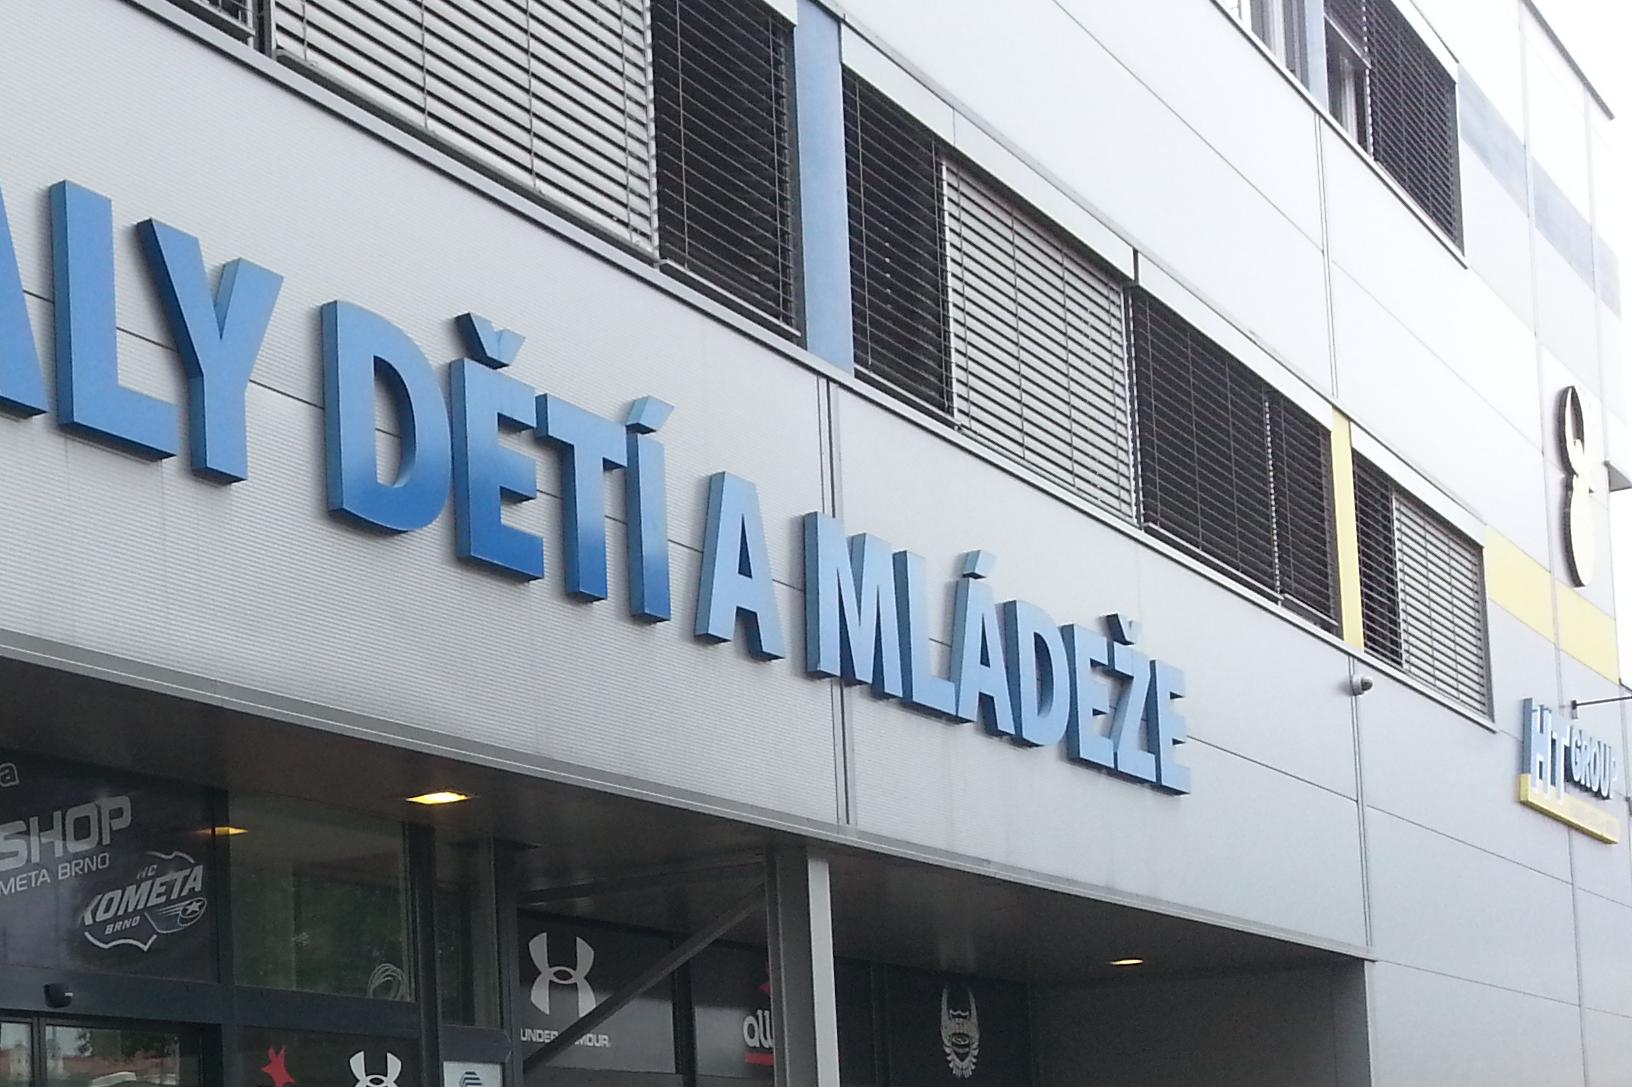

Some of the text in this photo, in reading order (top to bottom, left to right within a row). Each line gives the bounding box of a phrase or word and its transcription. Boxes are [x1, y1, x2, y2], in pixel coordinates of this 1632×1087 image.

[321, 298, 673, 624] DĚTÍ
[694, 471, 786, 661] A
[803, 511, 1192, 796] MLÁDEŽE
[58, 852, 110, 881] BRNO
[78, 865, 205, 927] KOMETA
[104, 916, 141, 936] BRNO
